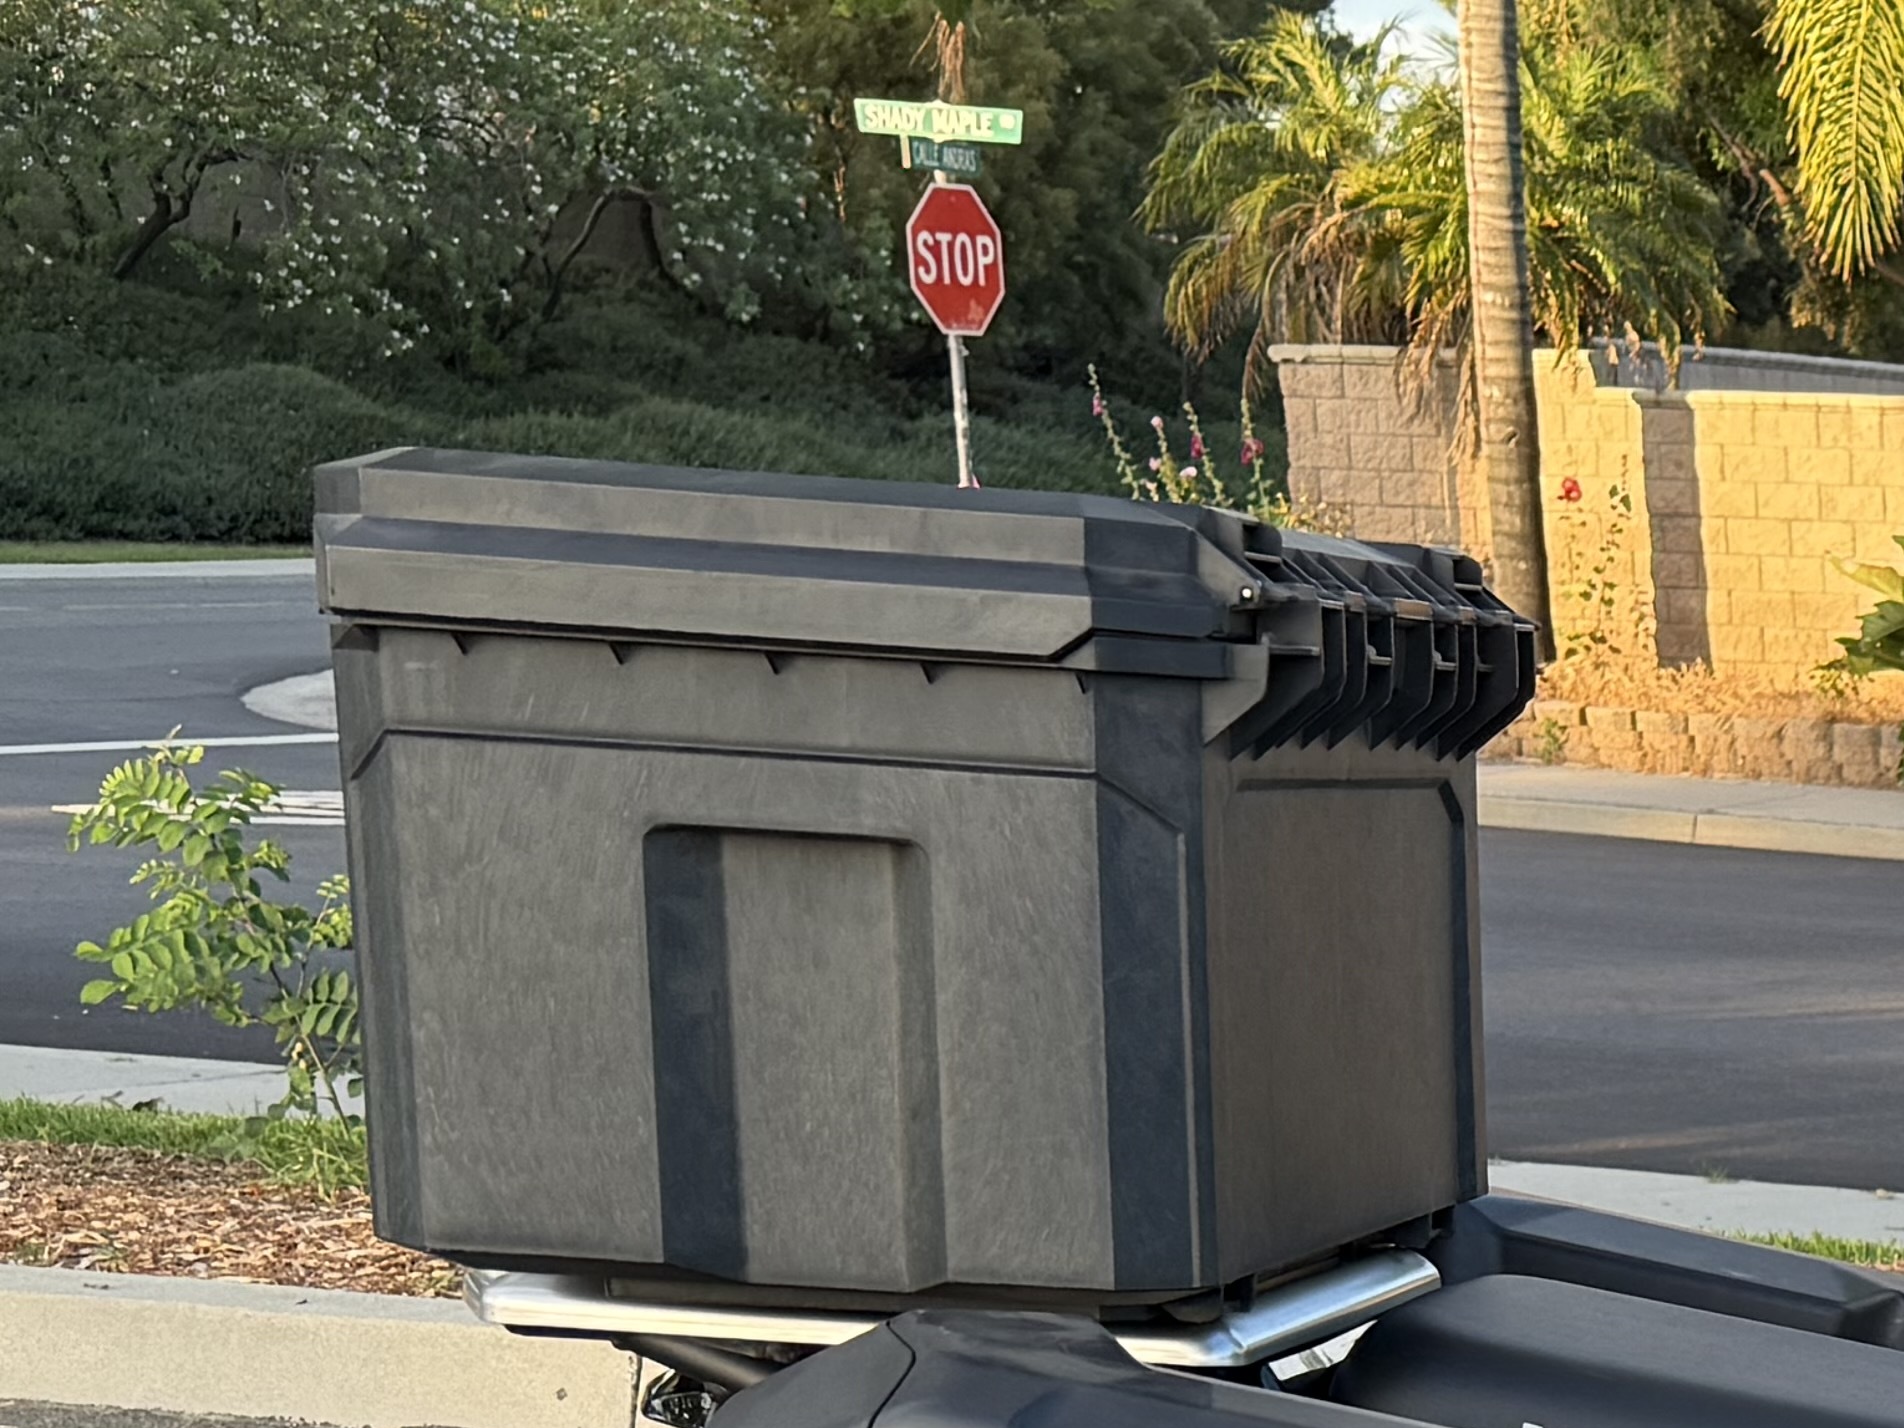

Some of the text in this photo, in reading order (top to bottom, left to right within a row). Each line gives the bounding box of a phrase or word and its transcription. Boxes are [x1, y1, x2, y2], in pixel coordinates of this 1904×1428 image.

[863, 103, 995, 138] SHADY MAPLE
[916, 229, 996, 287] STOP
